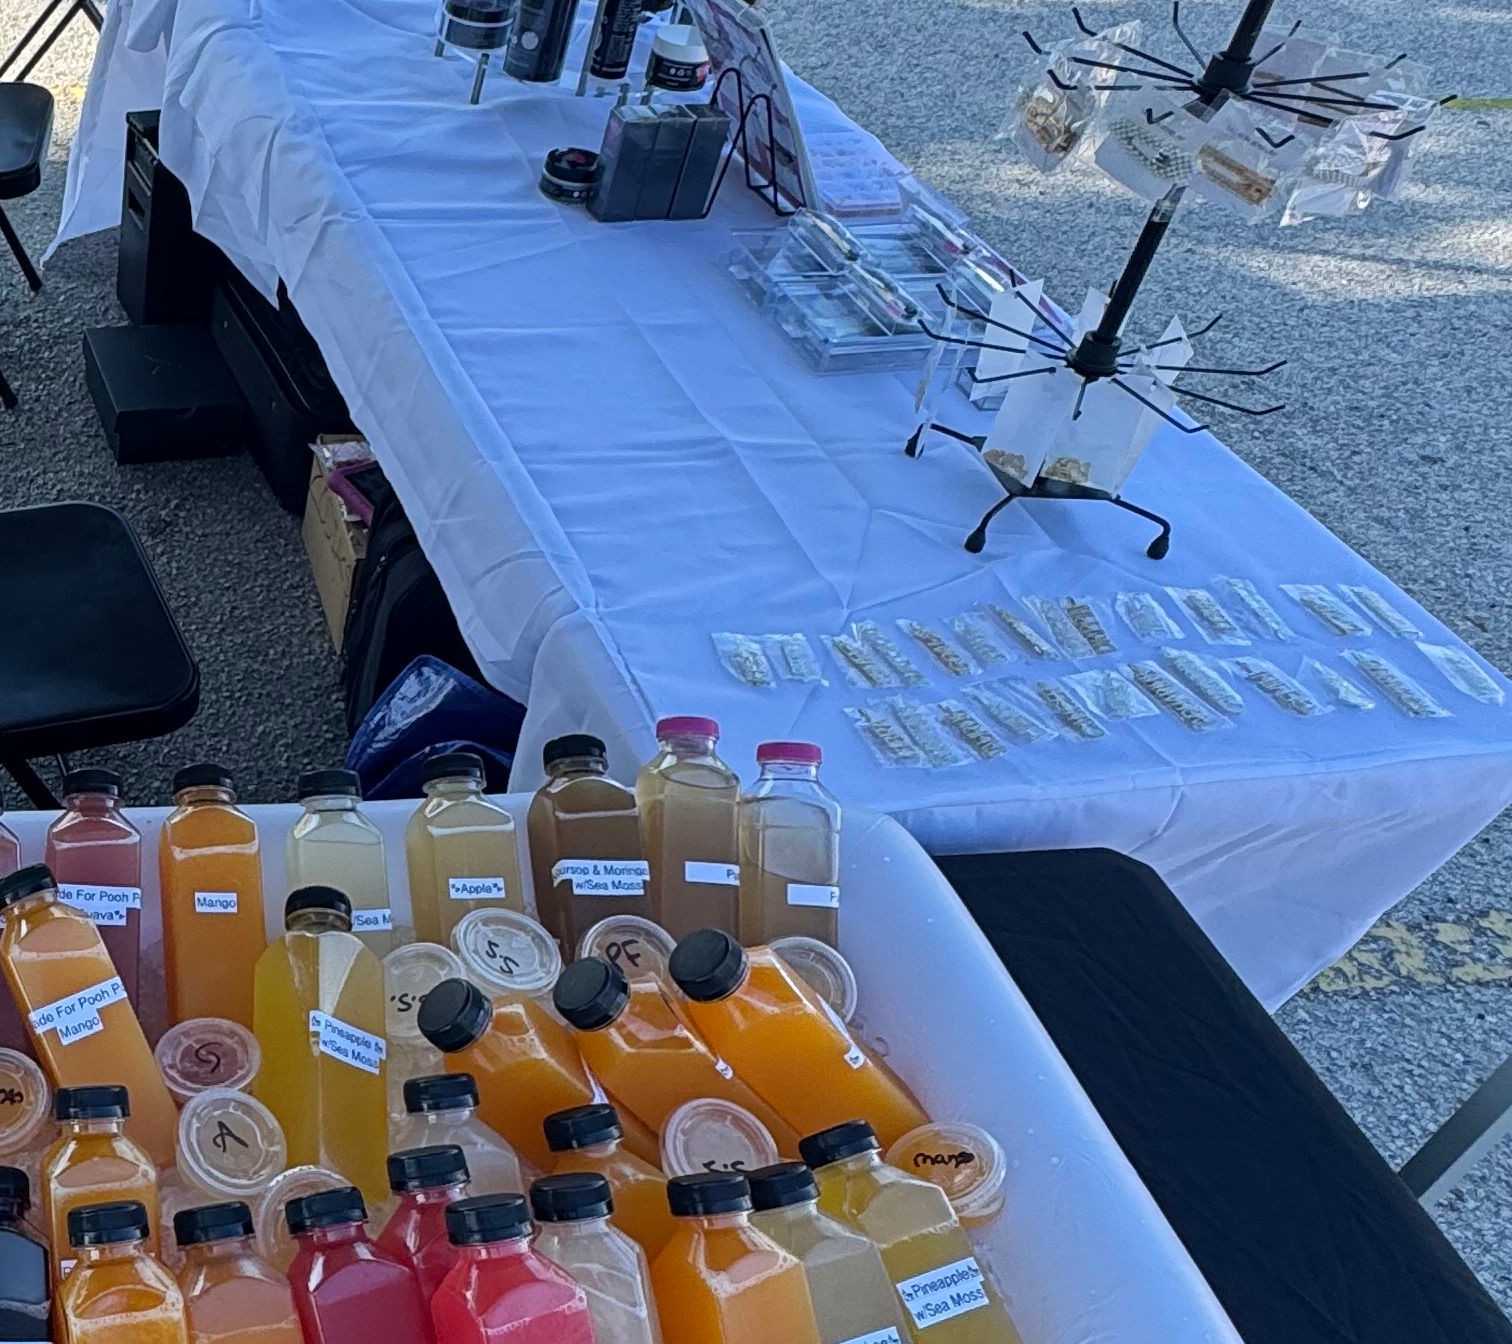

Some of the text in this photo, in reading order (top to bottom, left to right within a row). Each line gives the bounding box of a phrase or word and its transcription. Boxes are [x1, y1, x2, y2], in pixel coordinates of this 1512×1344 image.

[593, 864, 600, 876] &
[461, 882, 493, 895] Apple
[575, 879, 608, 890] w/Sea
[76, 889, 95, 901] For
[99, 890, 129, 903] Pooh
[198, 897, 235, 909] Mango
[55, 1002, 75, 1017] For
[78, 989, 110, 1009] Pooh
[58, 1016, 100, 1039] Mango
[324, 1017, 372, 1047] Pineapple
[351, 1051, 379, 1069] Moss
[212, 1120, 249, 1153] A
[912, 1268, 970, 1298] Pineapple
[915, 1287, 984, 1321] w/Sea Moss
